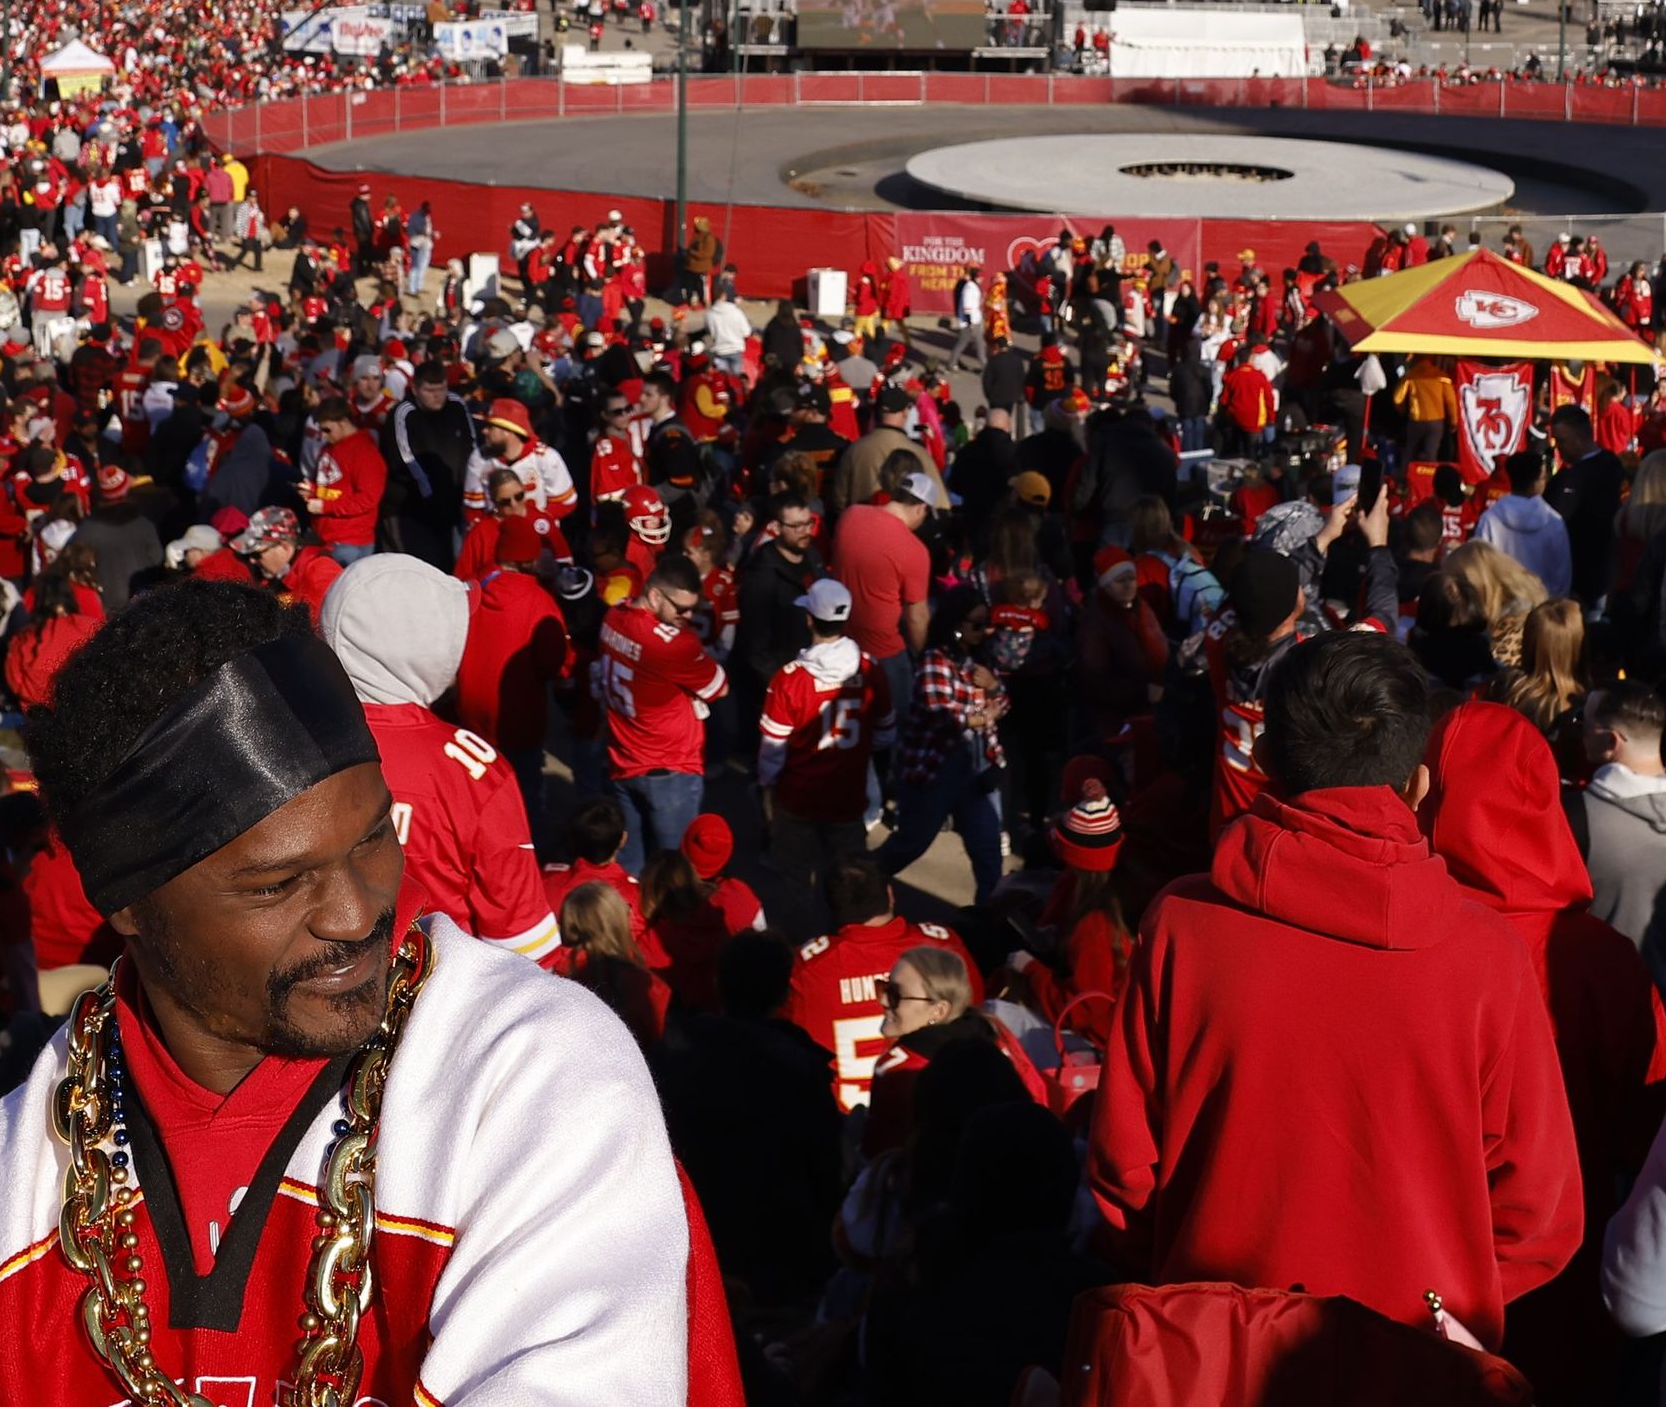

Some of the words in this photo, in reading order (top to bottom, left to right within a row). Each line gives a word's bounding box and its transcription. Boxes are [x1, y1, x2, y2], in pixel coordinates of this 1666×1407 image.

[903, 245, 985, 264] KINGDOM
[44, 278, 65, 301] 15
[159, 276, 176, 293] 15
[1476, 300, 1518, 319] KC
[818, 699, 861, 750] 15
[444, 728, 498, 781] 10
